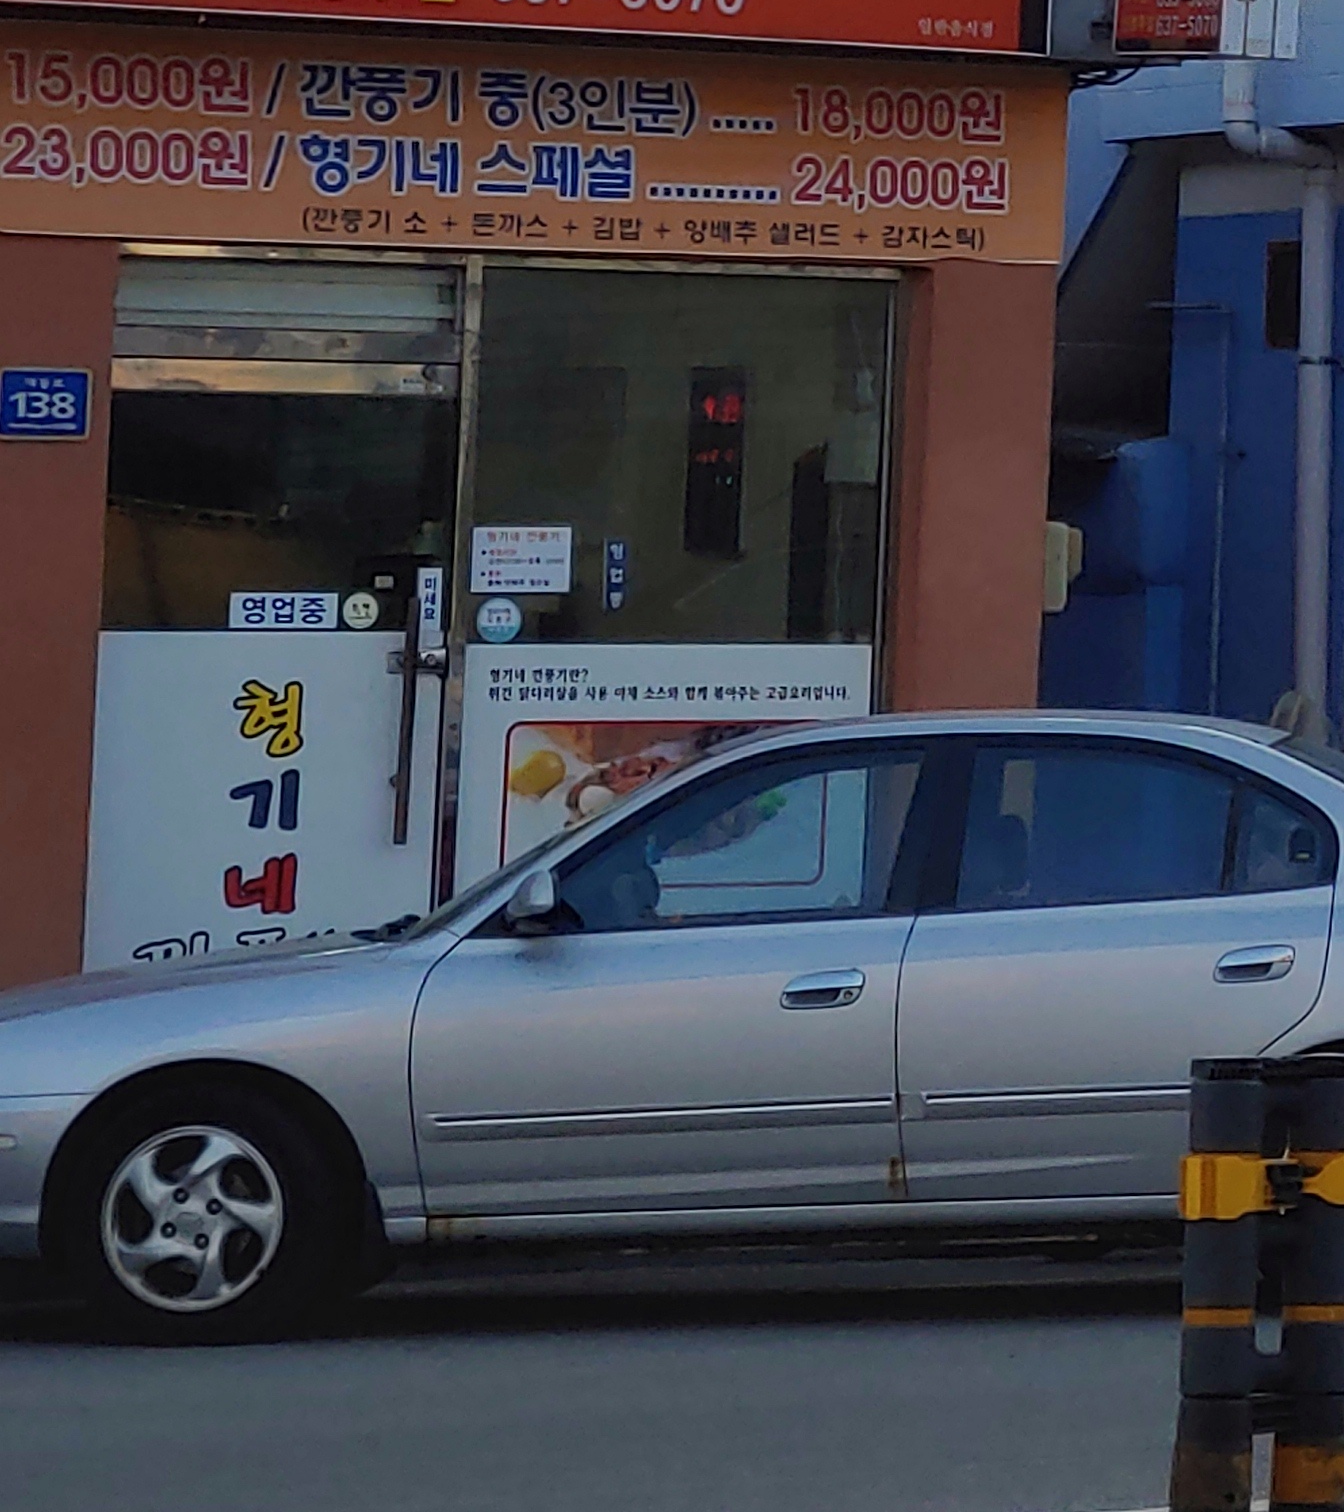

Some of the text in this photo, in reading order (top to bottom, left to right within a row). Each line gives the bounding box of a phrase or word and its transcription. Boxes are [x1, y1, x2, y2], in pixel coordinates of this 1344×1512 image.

[6, 51, 250, 115] 15,000원
[301, 62, 461, 124] 깐풍기
[794, 87, 1005, 144] 18,000원
[2, 125, 250, 188] 23,000원
[299, 133, 461, 195] 형기네
[476, 143, 634, 202] 스페셜
[792, 155, 1009, 214] 24,000원
[593, 215, 643, 240] 김밥
[8, 391, 77, 419] 138
[241, 595, 327, 625] 영업중
[223, 679, 305, 915] 형기네
